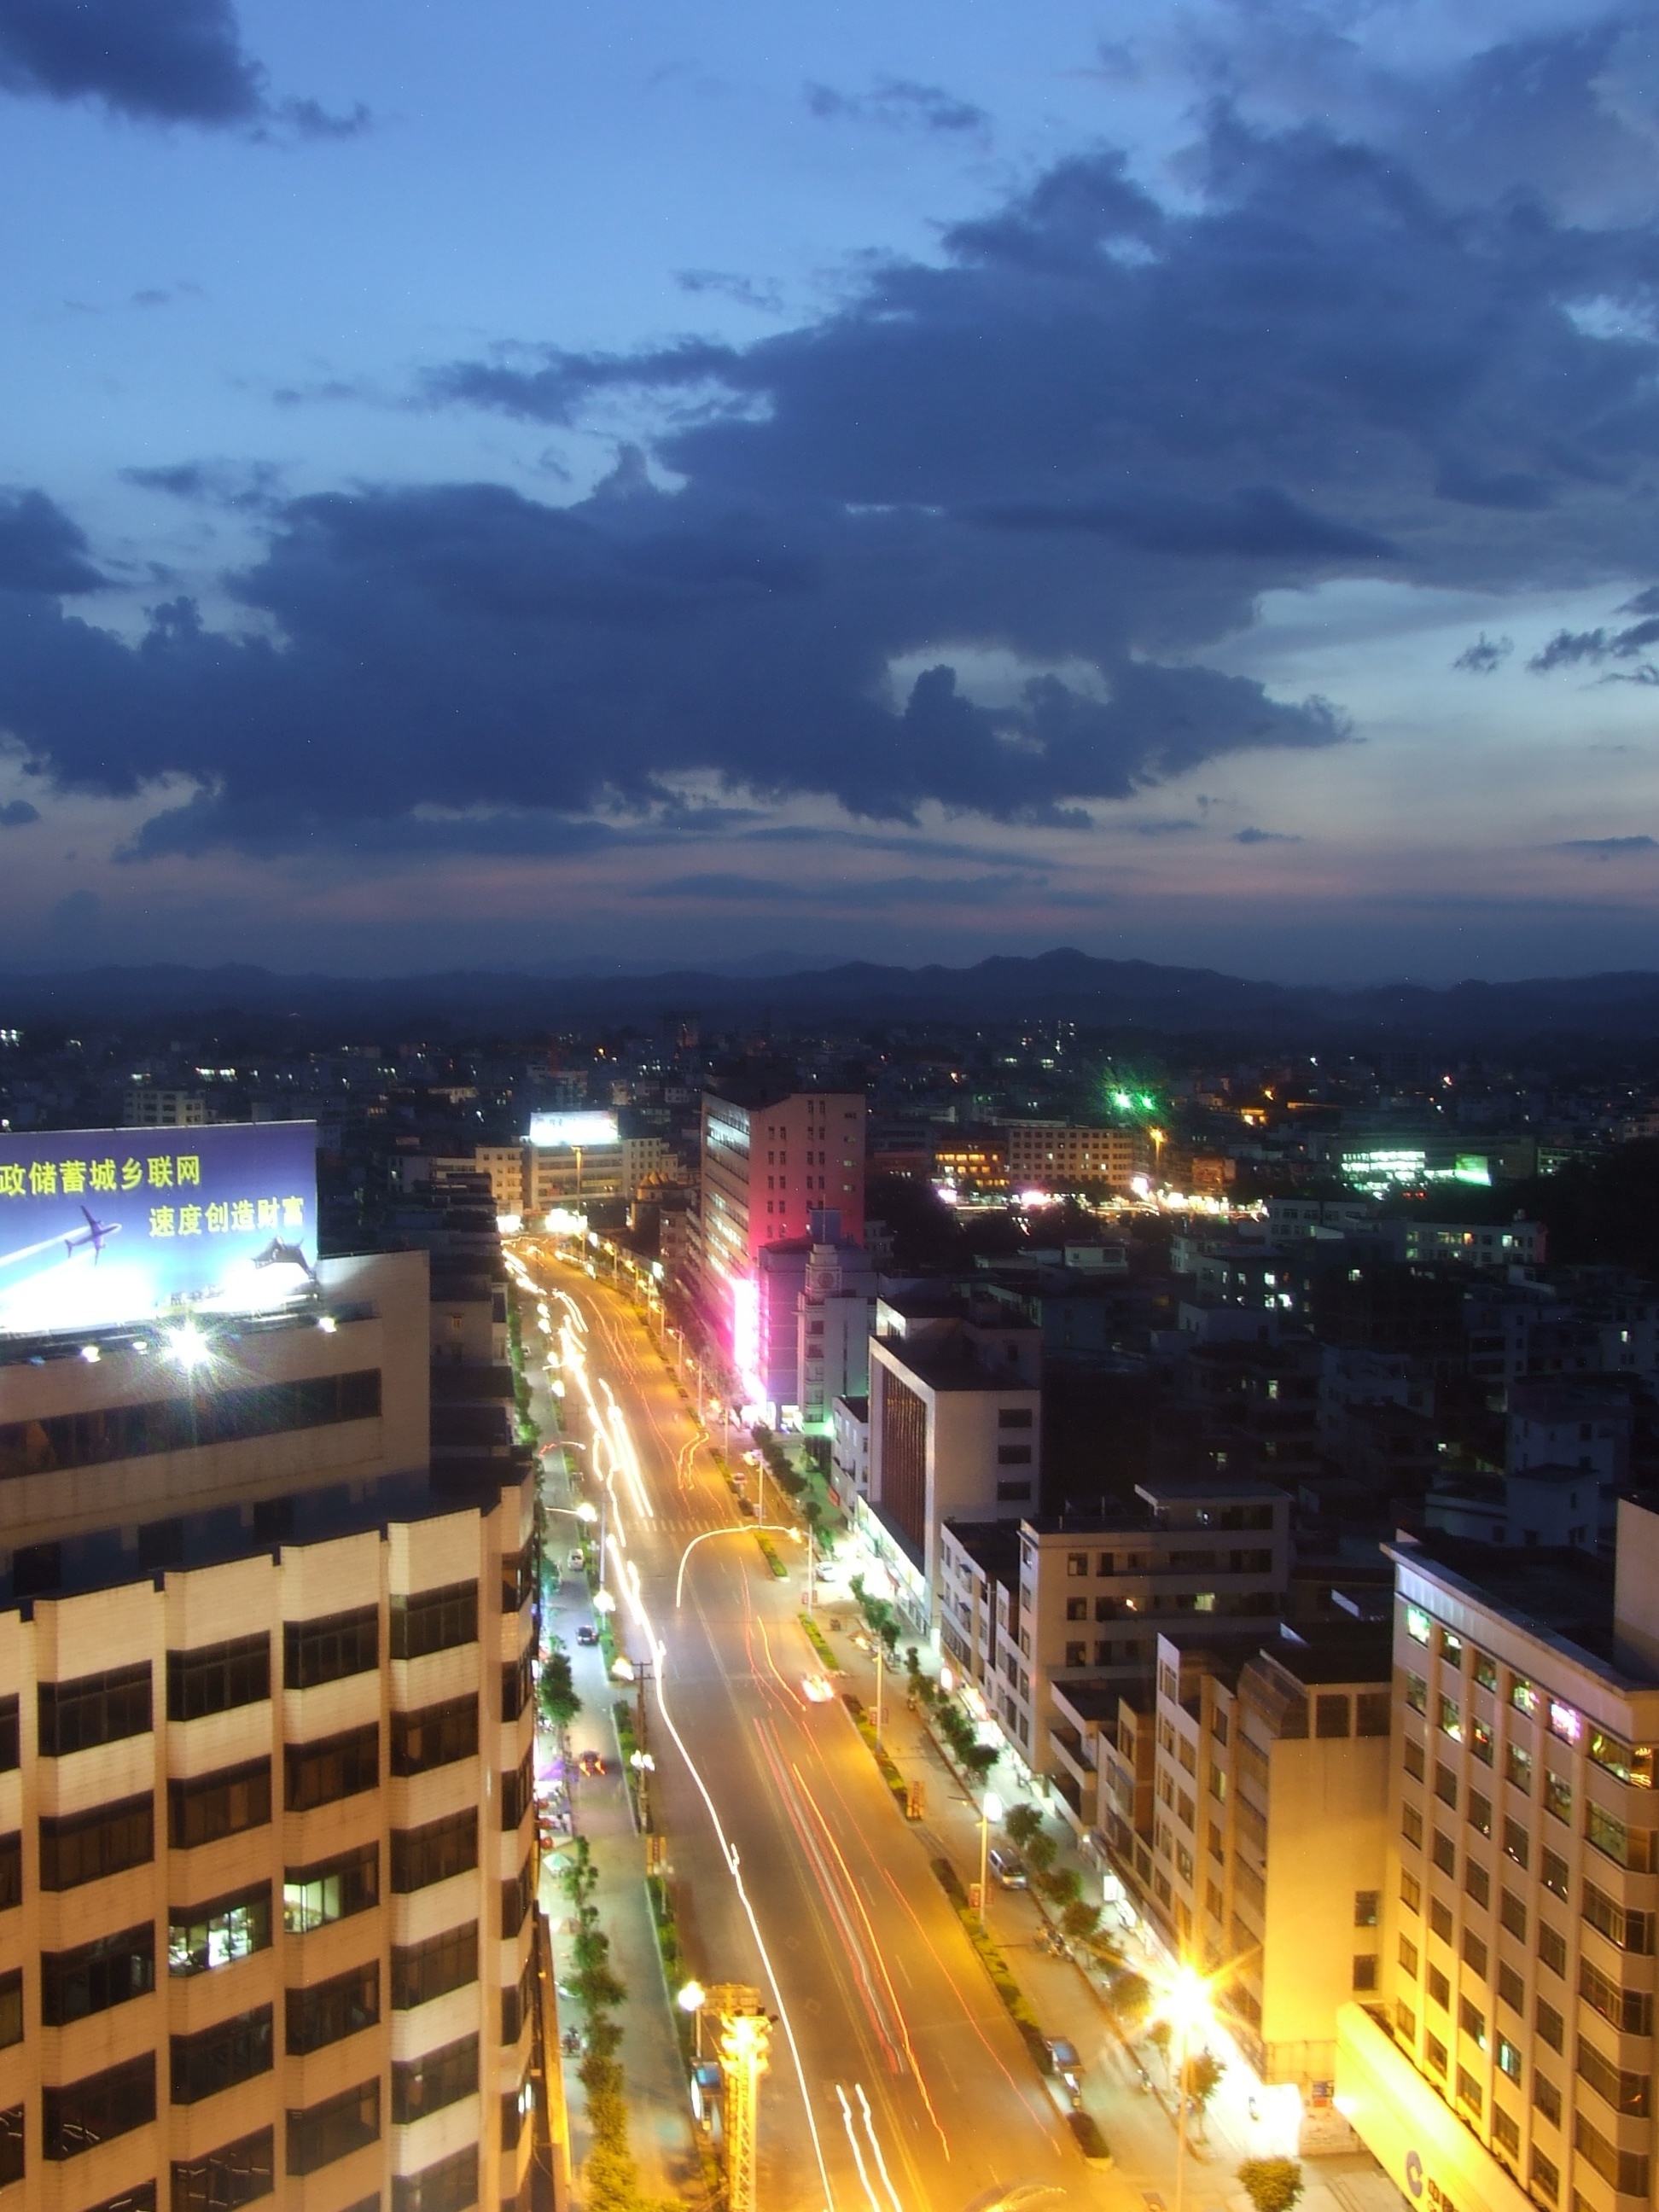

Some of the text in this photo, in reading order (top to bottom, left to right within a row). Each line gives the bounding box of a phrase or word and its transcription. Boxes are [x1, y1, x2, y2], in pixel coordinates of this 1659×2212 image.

[0, 1155, 200, 1196] 政储蓄城乡联网
[149, 1196, 304, 1237] 速度创造财富
